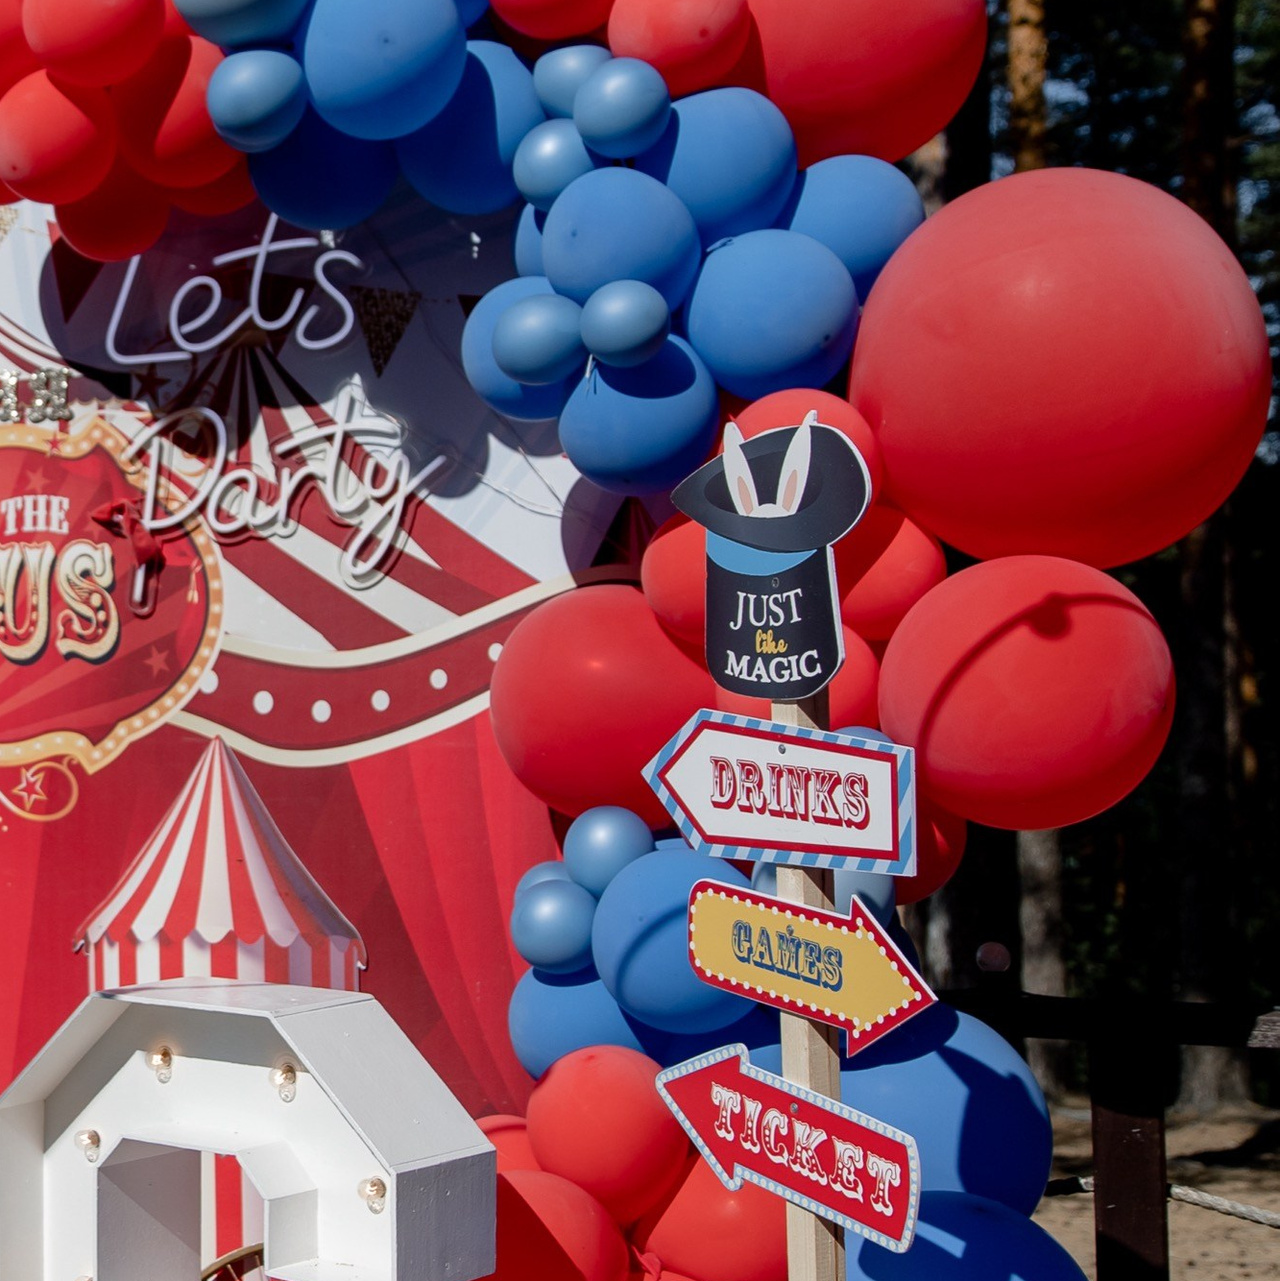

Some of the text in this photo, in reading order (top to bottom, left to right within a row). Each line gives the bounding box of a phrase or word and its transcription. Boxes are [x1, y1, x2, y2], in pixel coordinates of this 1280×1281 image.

[0, 494, 70, 536] THE
[122, 388, 448, 604] Party
[729, 588, 803, 631] JUST
[724, 649, 822, 683] MAGIC
[755, 629, 788, 654] like
[710, 755, 870, 830] DRINKS
[732, 920, 843, 992] GAMES
[710, 1081, 901, 1217] TICKET
